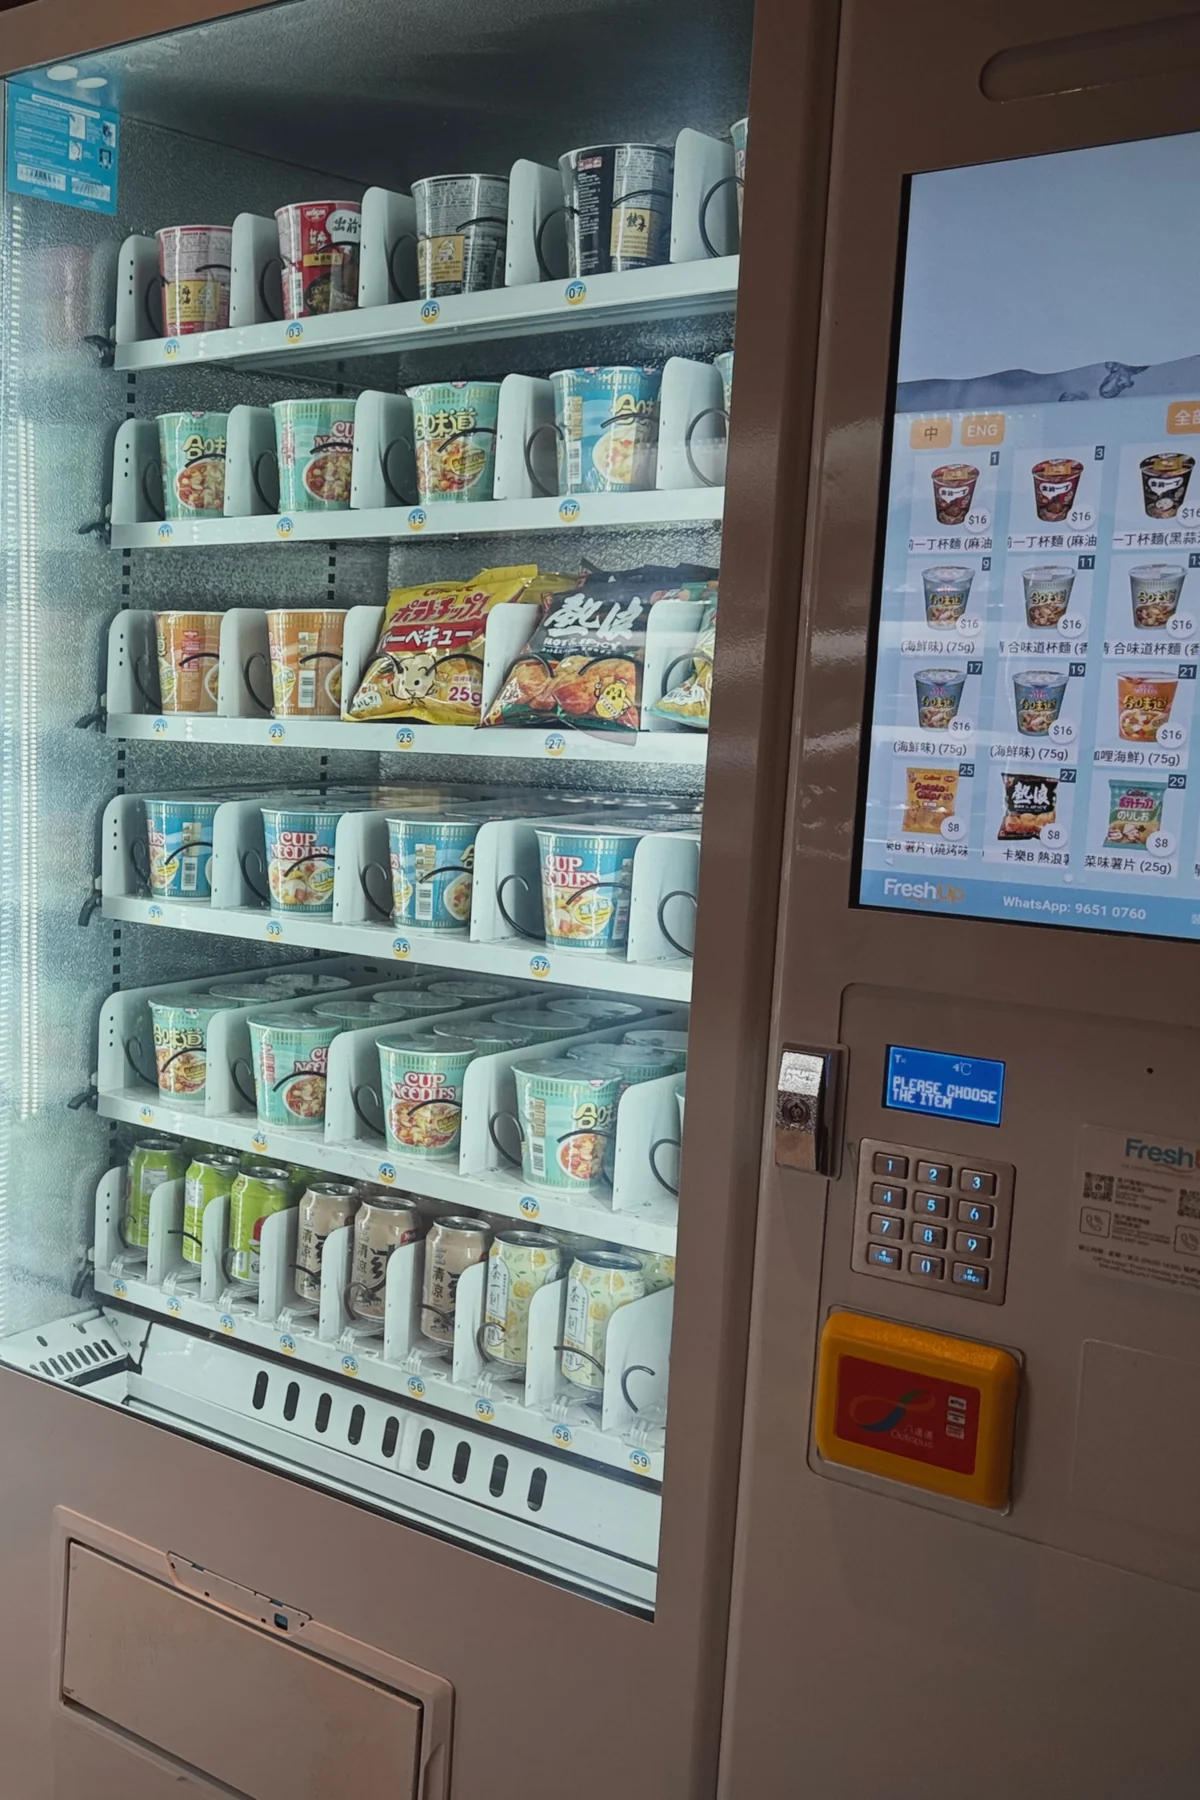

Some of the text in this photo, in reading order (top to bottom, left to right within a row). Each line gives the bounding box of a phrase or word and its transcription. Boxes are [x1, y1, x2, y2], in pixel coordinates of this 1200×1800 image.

[568, 286, 584, 300] 07
[422, 305, 438, 318] 05
[288, 326, 302, 340] 03
[414, 408, 478, 440] 合味道
[924, 426, 938, 441] 中
[967, 424, 998, 437] ENG
[562, 504, 578, 517] 17
[1071, 511, 1091, 522] $16
[1182, 508, 1200, 519] $16
[410, 513, 426, 526] 15
[968, 514, 987, 526] $16
[160, 528, 172, 539] 11
[278, 522, 292, 534] 13
[964, 538, 992, 550] (麻油
[1066, 534, 1098, 548] (麻油
[1080, 558, 1093, 567] 11
[960, 618, 979, 630] $16
[1062, 620, 1082, 630] $16
[1172, 620, 1192, 630] $16
[900, 640, 975, 654] (海鮮味) (75g)
[1008, 642, 1071, 654] 合味道杯麵
[1114, 642, 1181, 656] 合味道杯麵
[969, 664, 982, 673] 17
[1070, 665, 1084, 675] 19
[1180, 666, 1194, 677] 21
[448, 686, 482, 708] 25g
[1122, 695, 1168, 711] 合味道
[154, 722, 166, 734] 21
[270, 727, 284, 738] 23
[952, 722, 971, 732] $16
[1052, 724, 1072, 736] $16
[398, 732, 413, 744] 25
[1161, 729, 1182, 740] $16
[548, 737, 564, 750] 27
[893, 740, 967, 756] (海鮮味) (75g)
[990, 746, 1068, 761] (海鮮味) (75g)
[1148, 752, 1180, 766] (75g)
[960, 766, 974, 776] 25
[1062, 770, 1076, 781] 27
[1170, 776, 1184, 787] 29
[1117, 810, 1150, 822] のりしお
[948, 822, 960, 832] $8
[280, 832, 318, 846] CUP
[1047, 829, 1060, 841] $8
[1154, 838, 1168, 848] $8
[1002, 848, 1034, 862] 卡樂B
[545, 854, 584, 872] CUP
[1084, 854, 1172, 875] 菜味薯片 (25g)
[883, 878, 965, 904] FreshUp
[150, 908, 162, 920] 31
[1002, 896, 1146, 920] WhatsApp: 9651 0760
[268, 926, 282, 937] 33
[395, 942, 409, 954] 35
[533, 960, 548, 972] 37
[404, 1072, 446, 1088] CUP
[391, 1085, 456, 1101] NOODLES
[892, 1076, 998, 1105] PLEASE CHOOSE
[892, 1089, 953, 1110] THE ITEM
[1124, 1137, 1200, 1171] Fresh
[887, 1160, 892, 1172] 1
[380, 1168, 396, 1180] 45
[929, 1168, 938, 1181] 2
[972, 1177, 980, 1189] 3
[883, 1192, 892, 1204] 4
[522, 1201, 538, 1214] 47
[926, 1200, 936, 1212] 5
[970, 1208, 979, 1221] 6
[882, 1220, 890, 1233] 7
[924, 1230, 933, 1242] 8
[968, 1238, 977, 1251] 9
[920, 1260, 931, 1274] 0
[115, 1282, 126, 1293] 51
[168, 1300, 182, 1312] 52
[222, 1318, 235, 1330] 53
[281, 1338, 296, 1350] 54
[343, 1359, 358, 1371] 55
[410, 1382, 424, 1394] 56
[478, 1403, 492, 1416] 57
[555, 1429, 570, 1442] 58
[891, 1428, 934, 1449] Octopus
[632, 1454, 648, 1468] 59
